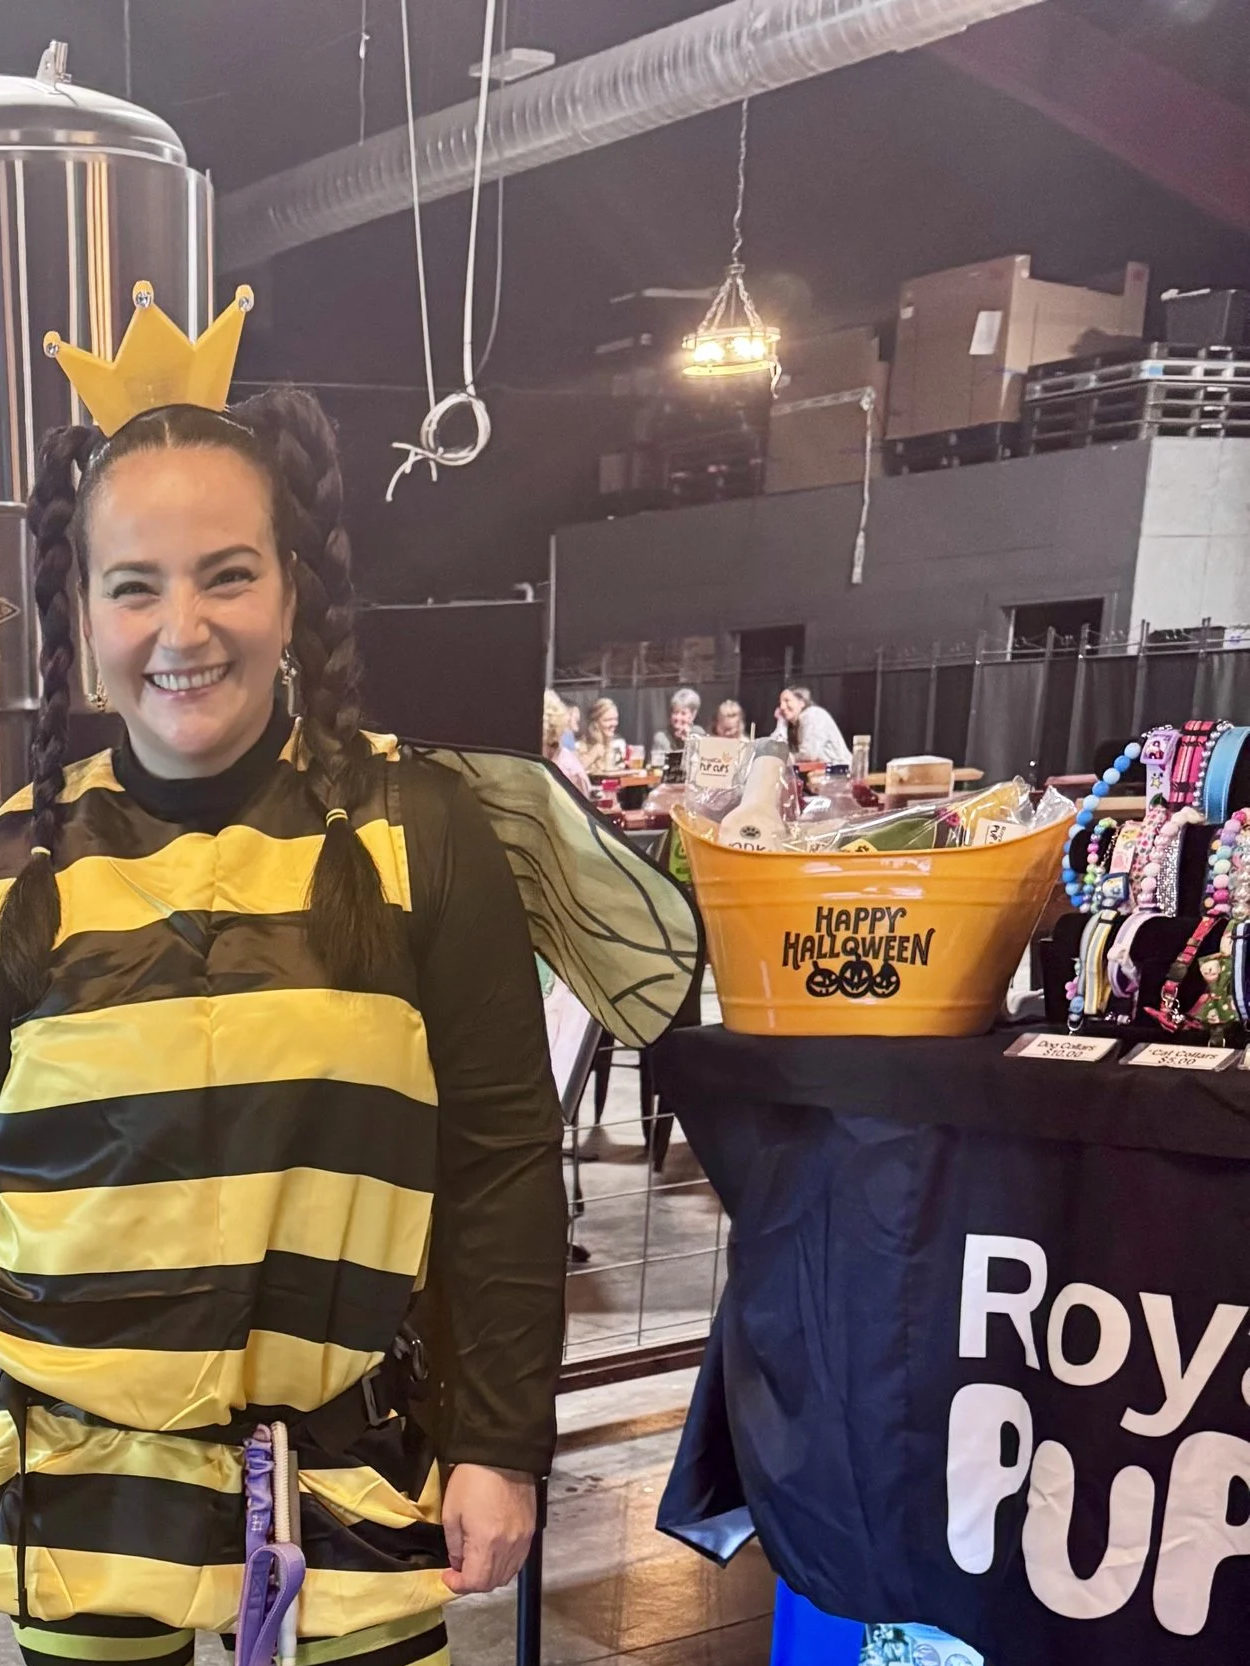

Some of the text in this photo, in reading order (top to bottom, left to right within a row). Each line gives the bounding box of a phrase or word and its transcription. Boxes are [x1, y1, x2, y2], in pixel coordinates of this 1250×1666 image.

[815, 906, 907, 937] HAPPY
[782, 928, 936, 970] HALLOWEEN
[1037, 1040, 1096, 1051] Dog Collars
[1043, 1048, 1084, 1058] $10.00
[1175, 1050, 1219, 1060] Collars
[958, 1233, 1250, 1438] Roy
[946, 1382, 1250, 1637] PUP
